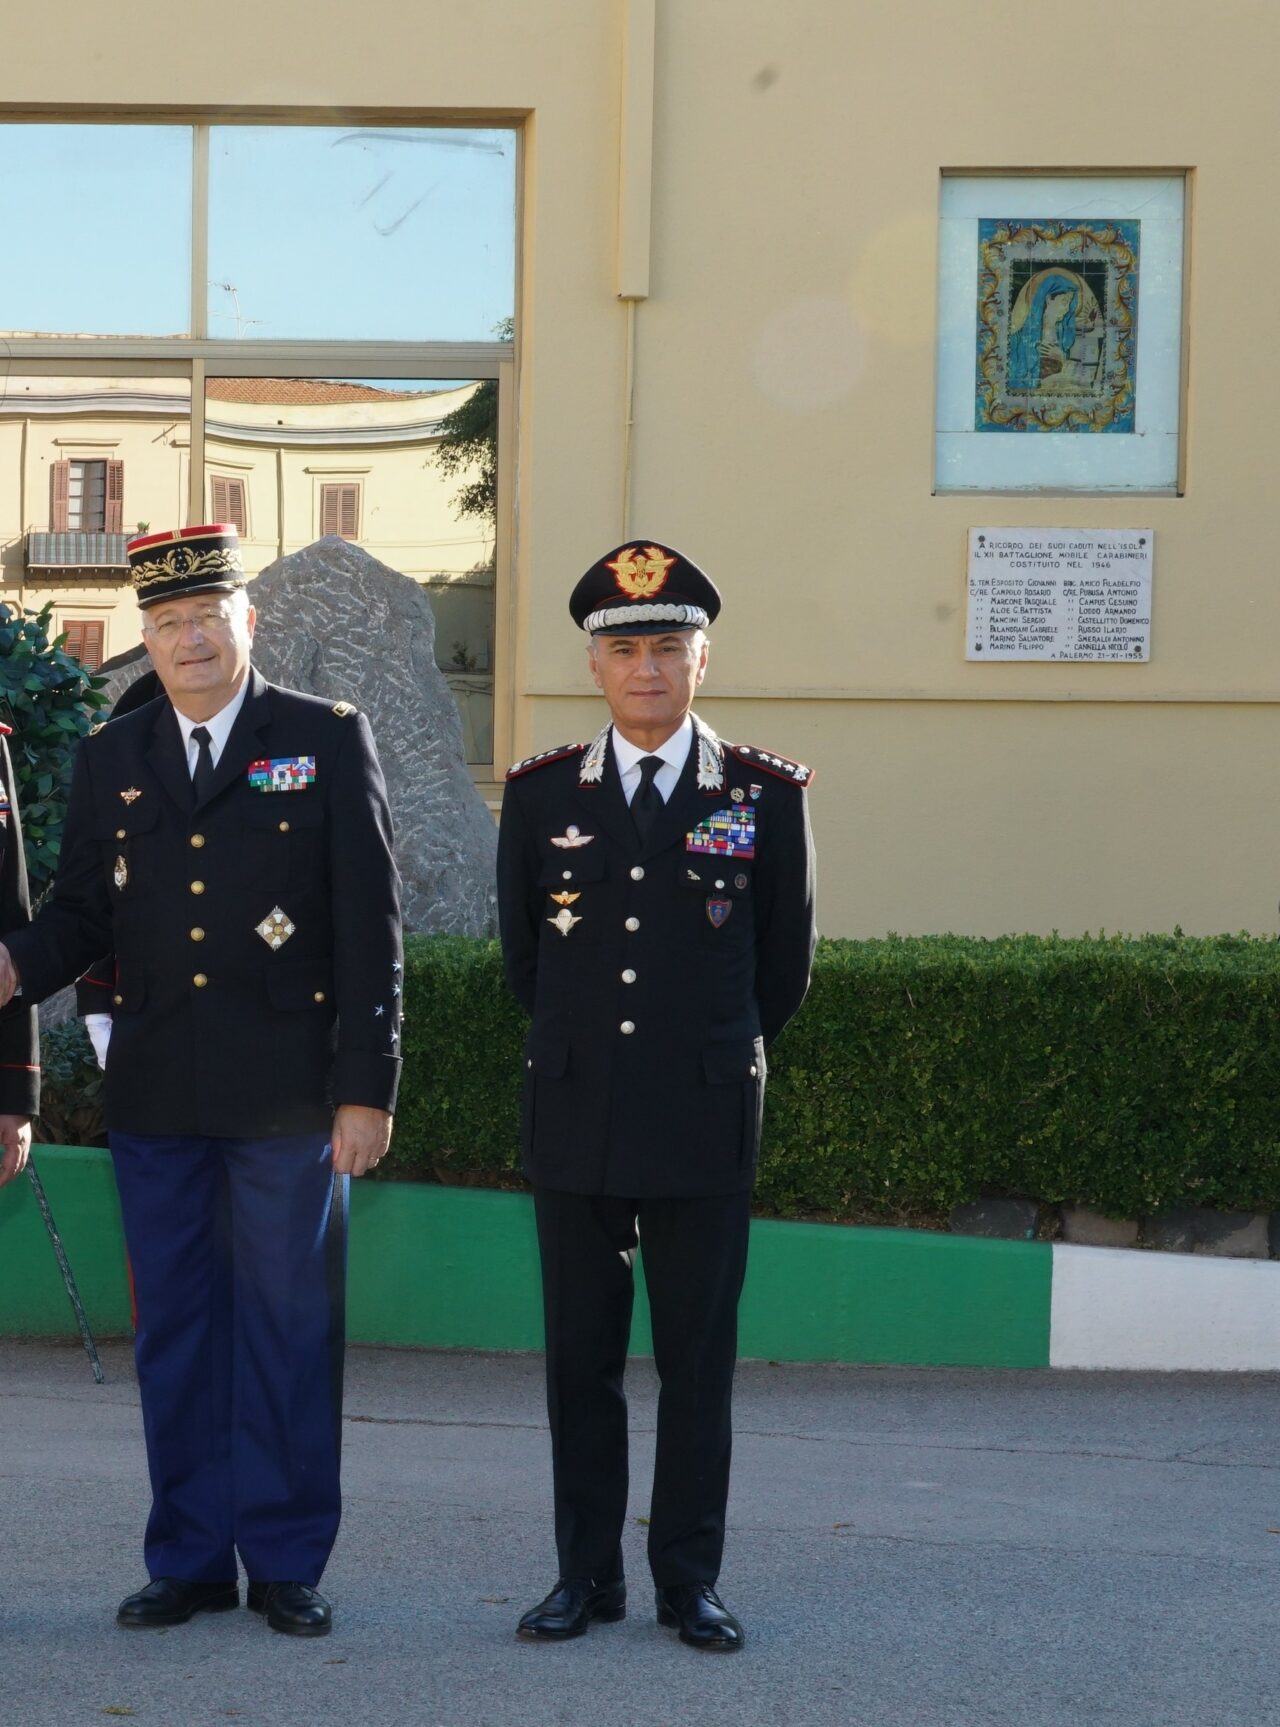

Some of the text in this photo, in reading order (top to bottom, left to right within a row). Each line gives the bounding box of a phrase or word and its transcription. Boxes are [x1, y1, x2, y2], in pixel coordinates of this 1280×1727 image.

[989, 542, 1024, 550] RICORDO
[1028, 542, 1042, 550] DEI
[1047, 542, 1066, 550] SUOI
[1096, 552, 1147, 560] CARABINIERI
[991, 578, 1024, 586] ESPOSITO
[1027, 578, 1057, 586] GIOVANNI
[1102, 579, 1141, 587] FILADELFIO
[991, 587, 1022, 596] CAMPOLO
[1024, 588, 1051, 596] ROSARIO
[1106, 588, 1138, 596] ANTONIO
[990, 597, 1023, 605] MARCONE
[1024, 598, 1057, 606] PASQUALE
[1079, 597, 1106, 606] CAMPUS
[1108, 598, 1138, 606] GESUINO
[1104, 607, 1137, 615] ARMANDO
[1022, 616, 1046, 624] SERGIO
[1077, 616, 1118, 624] CASTELLITTO
[1119, 617, 1149, 625] DOMENICO
[1029, 625, 1059, 633] GABRIELE
[1078, 625, 1101, 633] RUSSO
[1103, 626, 1127, 634] ILARIO
[989, 634, 1016, 642] MARINO
[1018, 634, 1055, 643] SALVATORE
[1112, 635, 1144, 643] ANTONINO
[1074, 643, 1106, 651] CANNELLA
[1059, 651, 1094, 659] PALERMO
